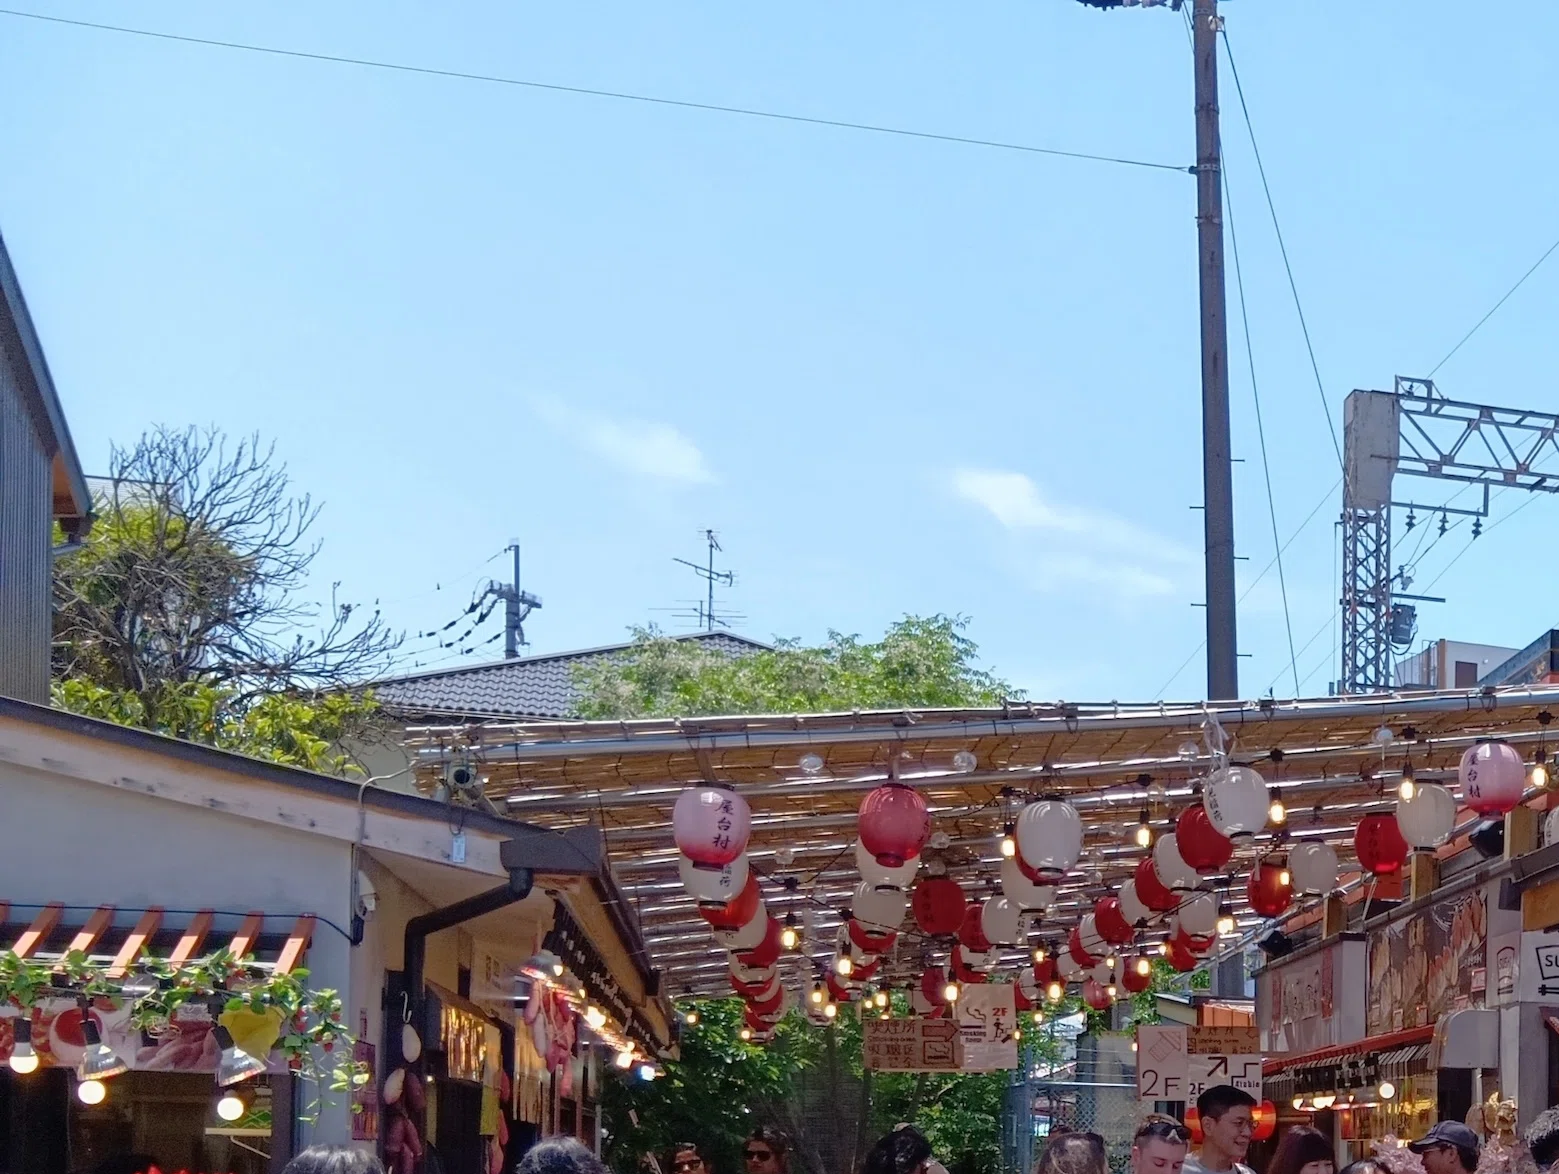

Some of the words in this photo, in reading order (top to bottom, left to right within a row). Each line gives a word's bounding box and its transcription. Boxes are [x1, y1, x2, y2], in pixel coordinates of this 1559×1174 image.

[712, 800, 735, 850] 屋台村
[1142, 1069, 1181, 1097] 2F
[1189, 1083, 1206, 1095] 2F
